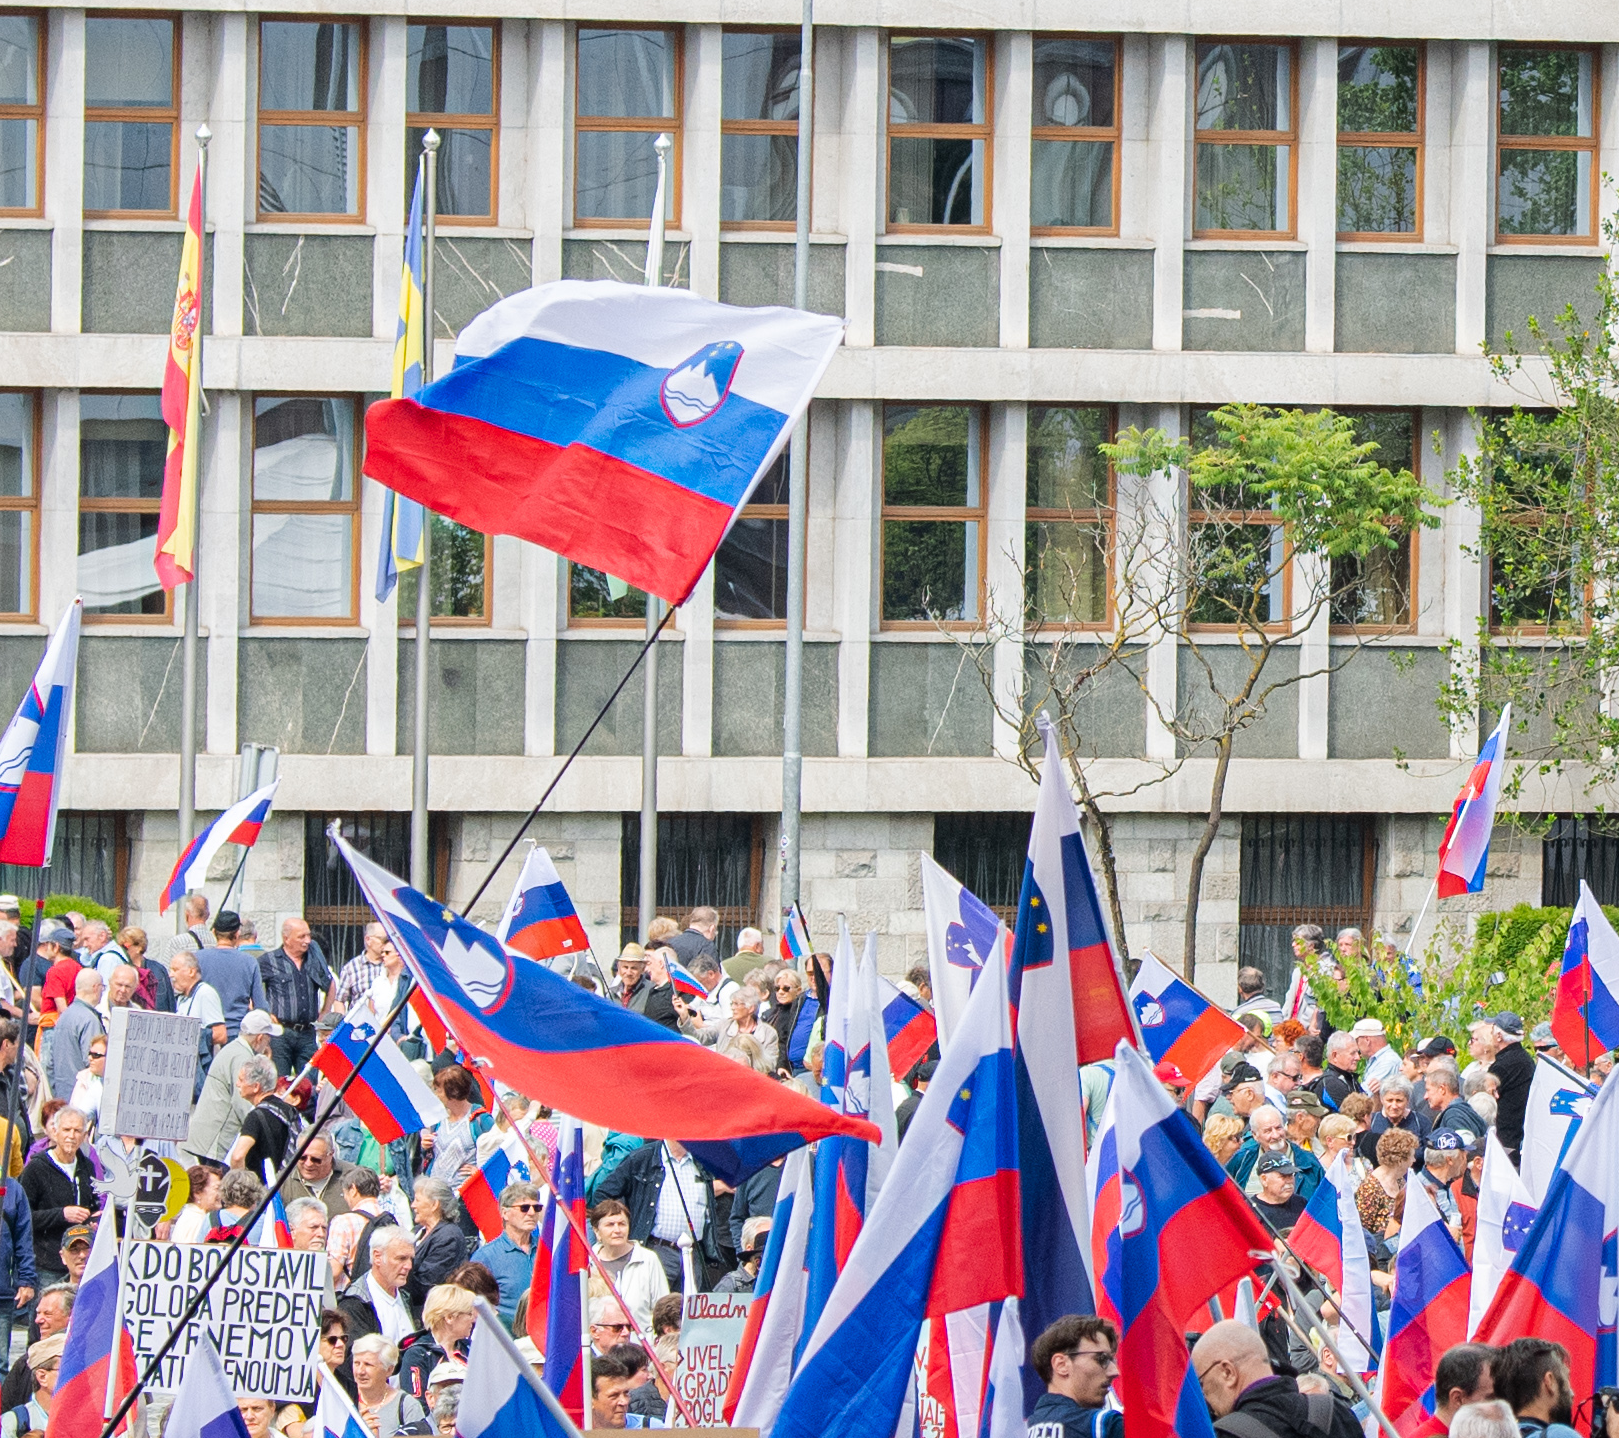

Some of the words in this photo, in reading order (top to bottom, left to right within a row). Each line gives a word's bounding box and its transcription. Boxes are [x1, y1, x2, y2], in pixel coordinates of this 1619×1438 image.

[227, 1250, 324, 1292] USTAVIL
[222, 1288, 324, 1327] PREDEN
[688, 1294, 749, 1320] Vladn
[302, 1328, 320, 1362] V
[687, 1344, 739, 1372] UVELJ
[684, 1371, 732, 1400] GRAD
[685, 1398, 724, 1426] POGL
